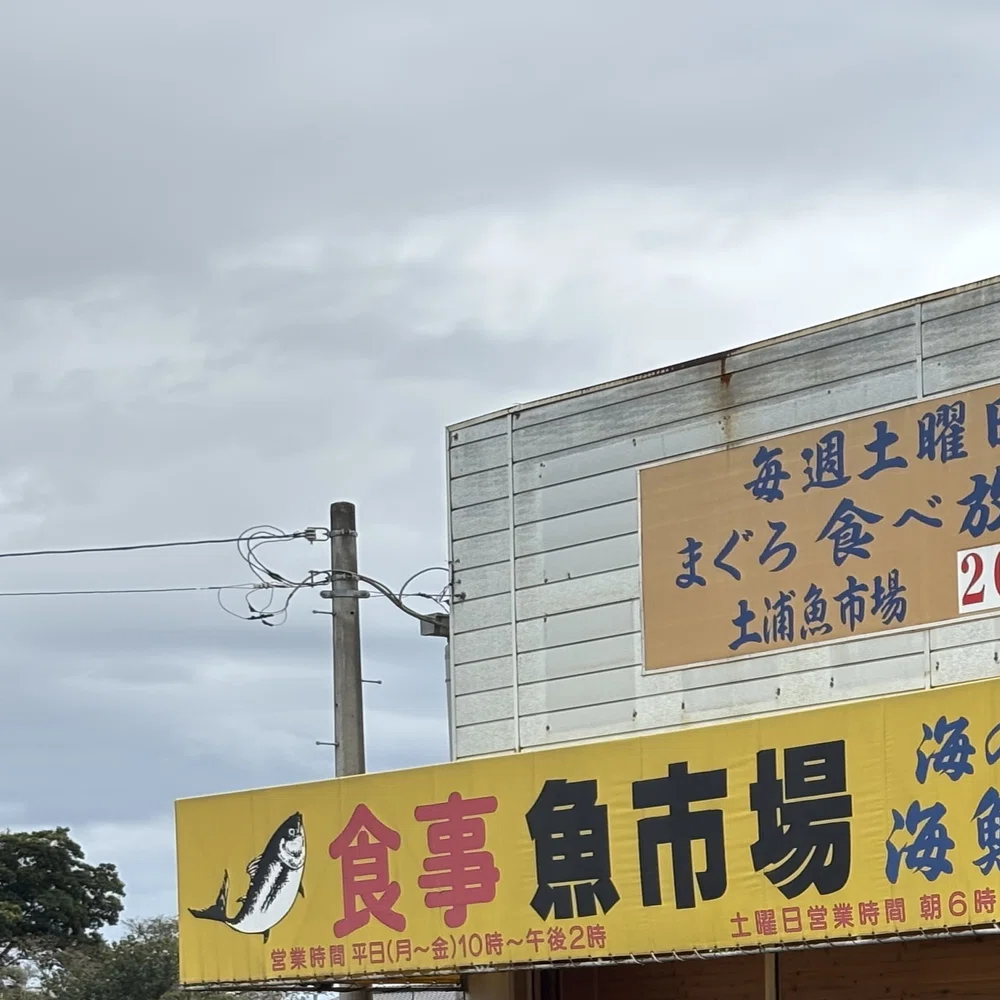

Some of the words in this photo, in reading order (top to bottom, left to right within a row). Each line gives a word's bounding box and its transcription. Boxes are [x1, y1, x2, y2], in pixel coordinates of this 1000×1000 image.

[728, 569, 908, 651] 土浦魚市場
[328, 791, 501, 938] 食事
[525, 739, 853, 922] 魚市場
[270, 944, 346, 972] 営業時間
